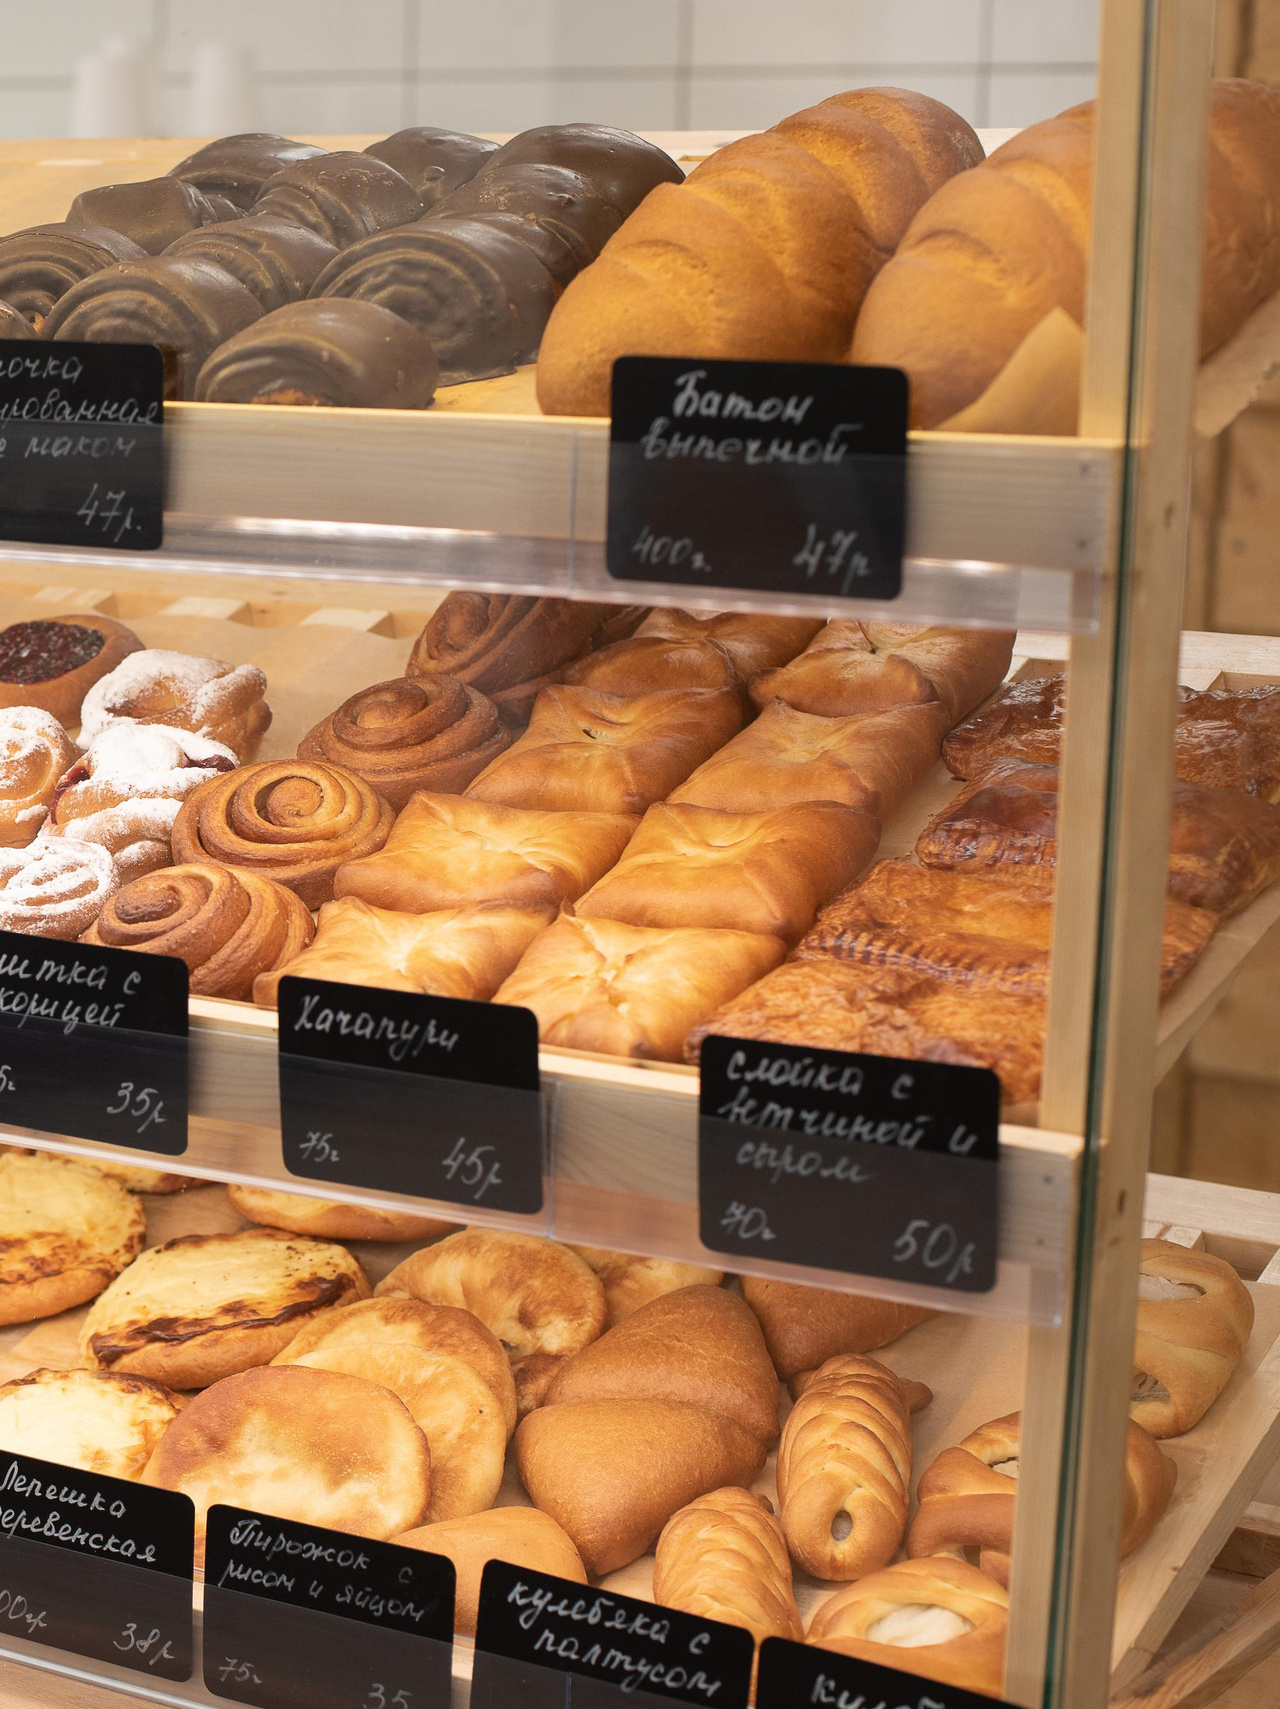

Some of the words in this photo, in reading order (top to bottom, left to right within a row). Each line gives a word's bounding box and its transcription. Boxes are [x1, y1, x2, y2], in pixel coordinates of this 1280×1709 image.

[673, 369, 814, 425] Батон
[24, 436, 136, 459] маком
[123, 971, 141, 995] с
[294, 995, 460, 1062] Хачапури
[891, 1073, 915, 1100] с
[948, 1123, 979, 1156] и
[736, 1141, 871, 1185] сыром
[230, 1518, 370, 1570] Пирожок
[398, 1566, 412, 1583] с
[218, 1559, 295, 1592] рисом
[309, 1580, 324, 1598] и
[336, 1584, 425, 1622] яйцом
[535, 1629, 723, 1697] палтусом
[688, 1632, 710, 1655] с
